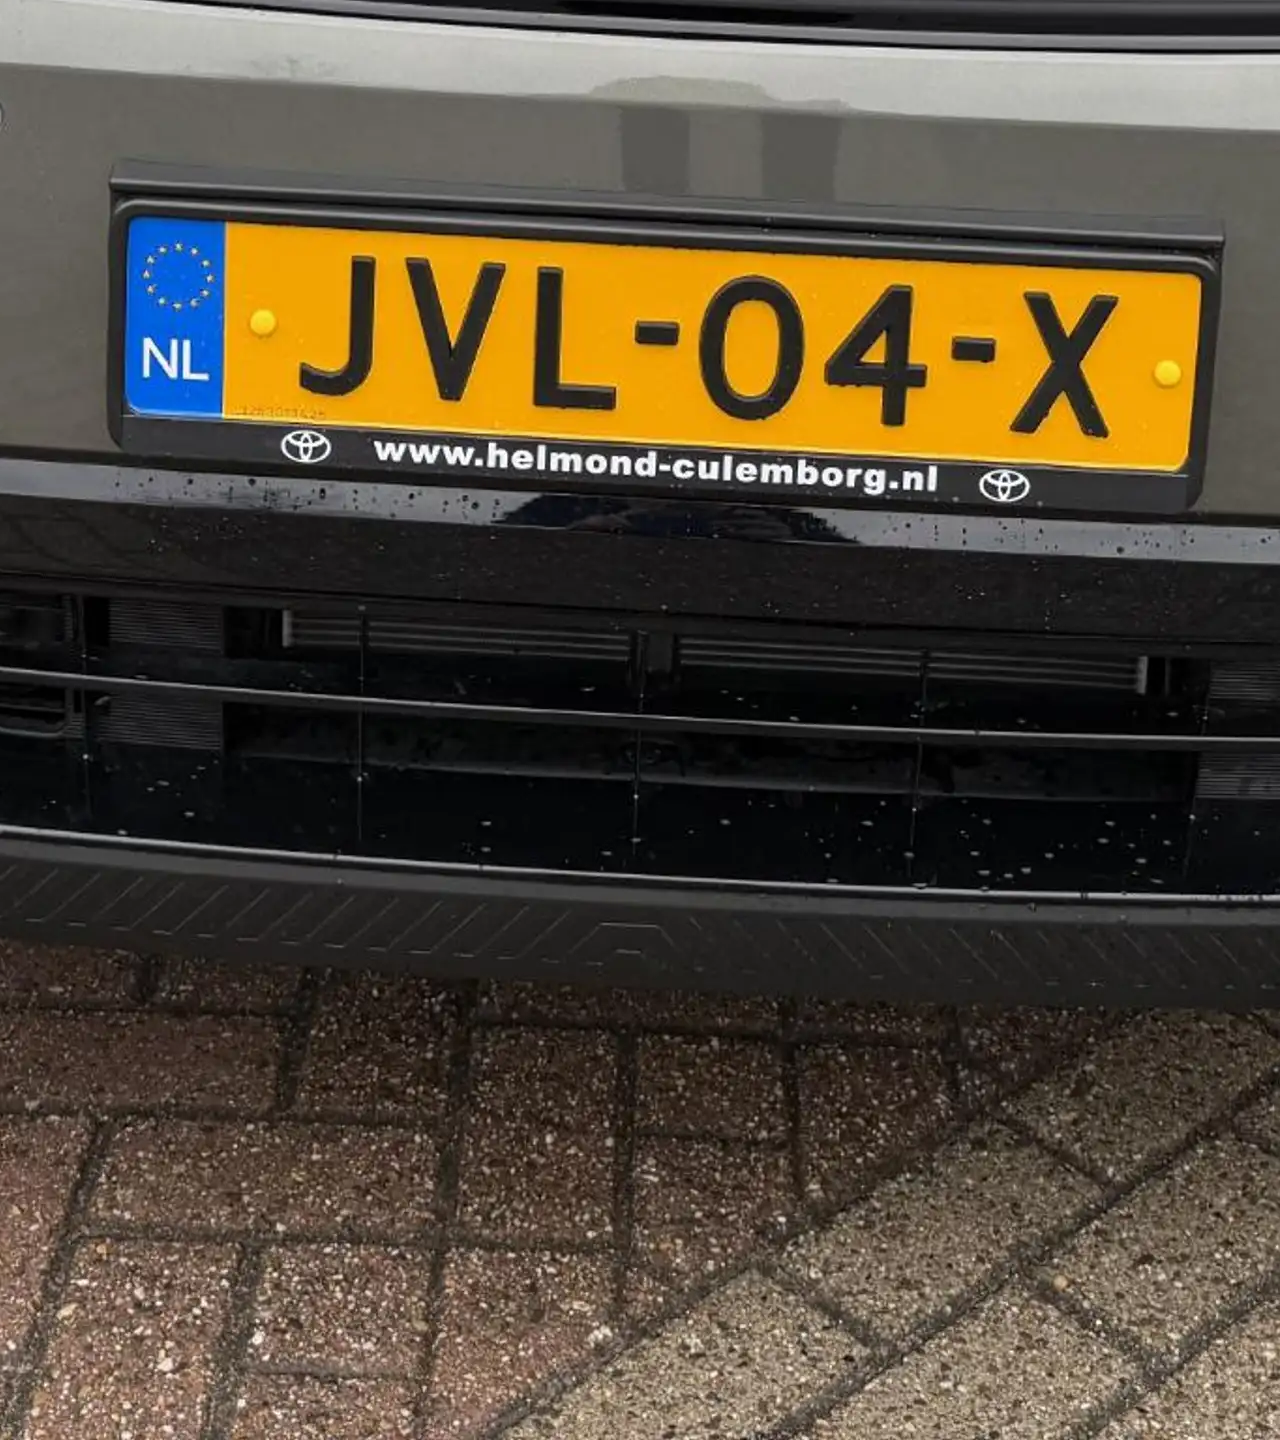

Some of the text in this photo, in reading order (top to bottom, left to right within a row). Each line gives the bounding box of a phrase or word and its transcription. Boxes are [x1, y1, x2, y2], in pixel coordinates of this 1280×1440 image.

[141, 336, 209, 382] NL
[297, 254, 1120, 440] JVL-04-X
[371, 434, 939, 495] www.helmond-culemborg.nl
